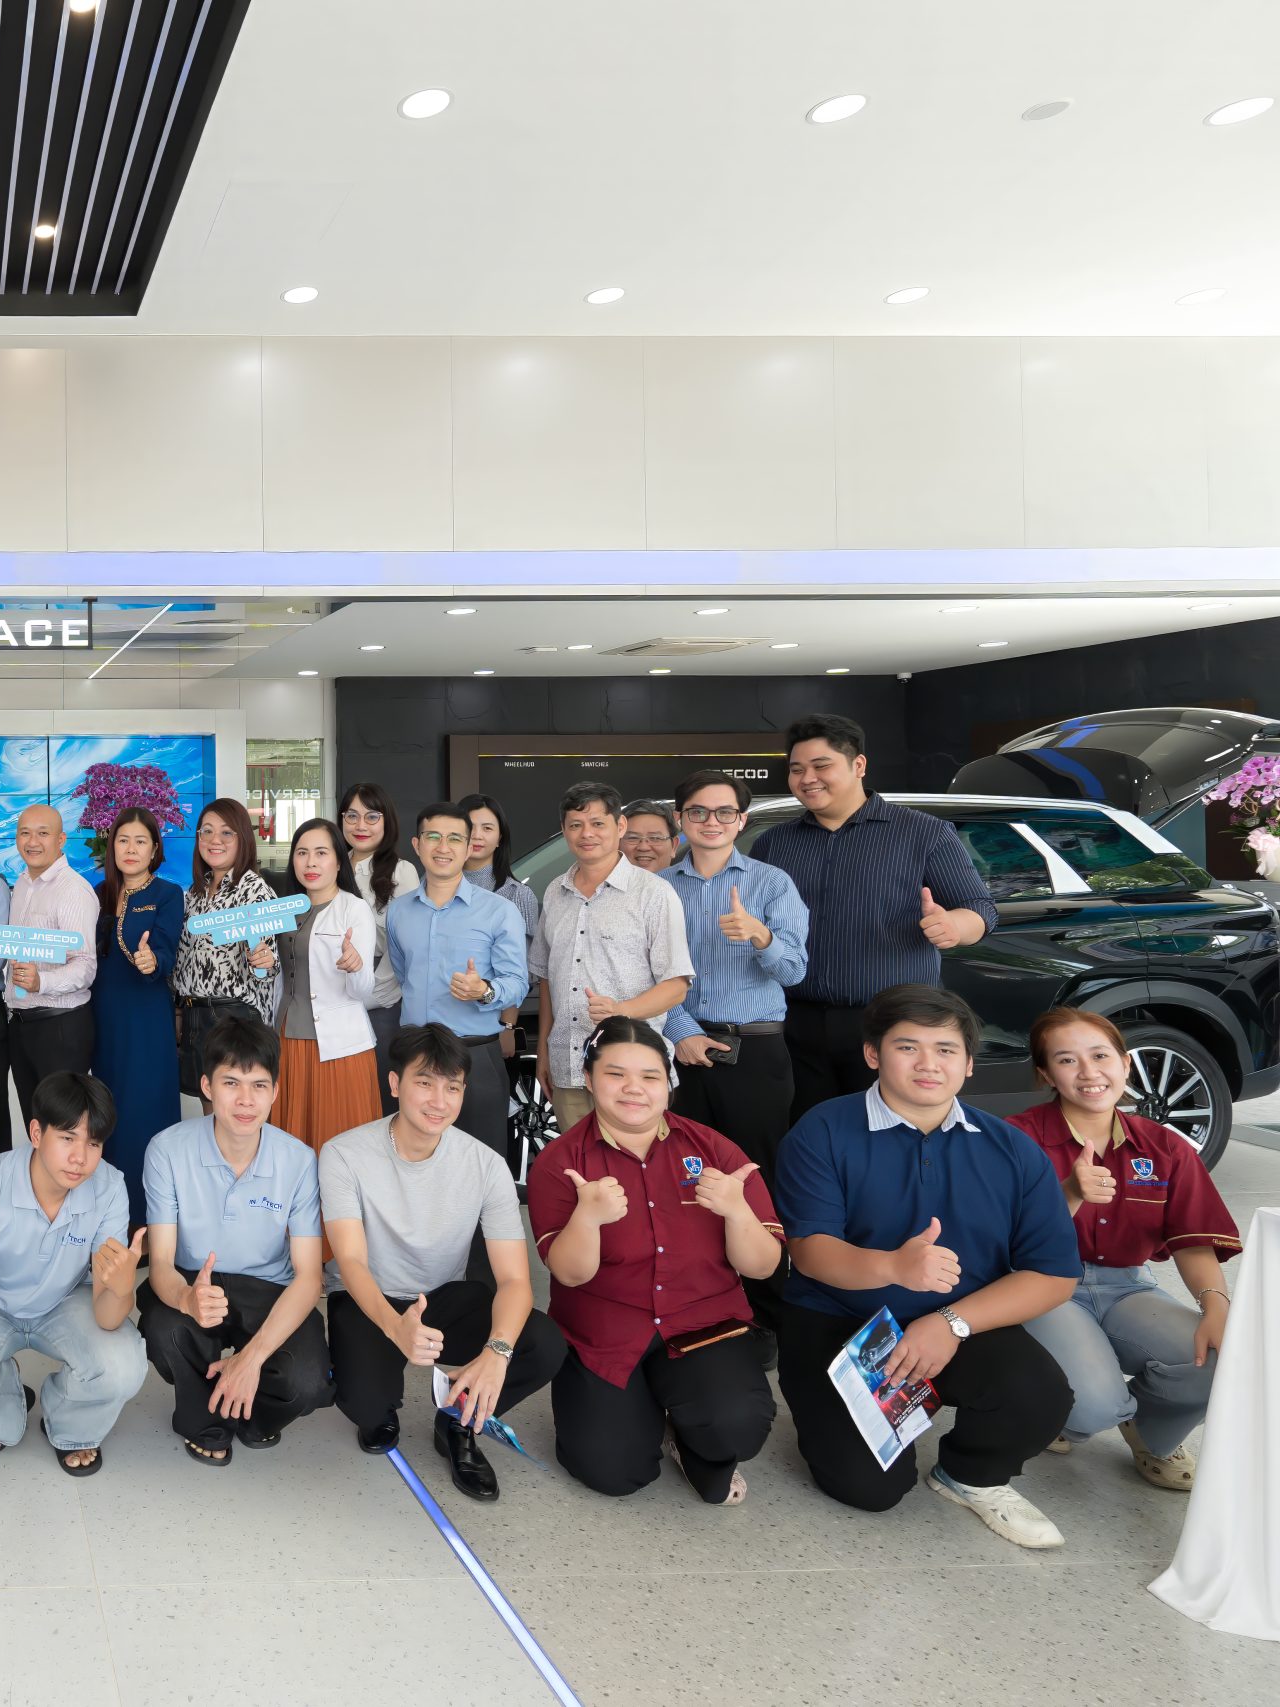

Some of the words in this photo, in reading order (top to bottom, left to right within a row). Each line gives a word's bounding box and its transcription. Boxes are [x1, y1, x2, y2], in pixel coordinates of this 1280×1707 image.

[722, 769, 769, 779] ECOO
[193, 912, 245, 929] OMODA
[253, 899, 304, 916] JAECOO
[250, 919, 284, 935] NINH
[28, 932, 78, 944] JAECOO
[22, 946, 54, 959] NINH
